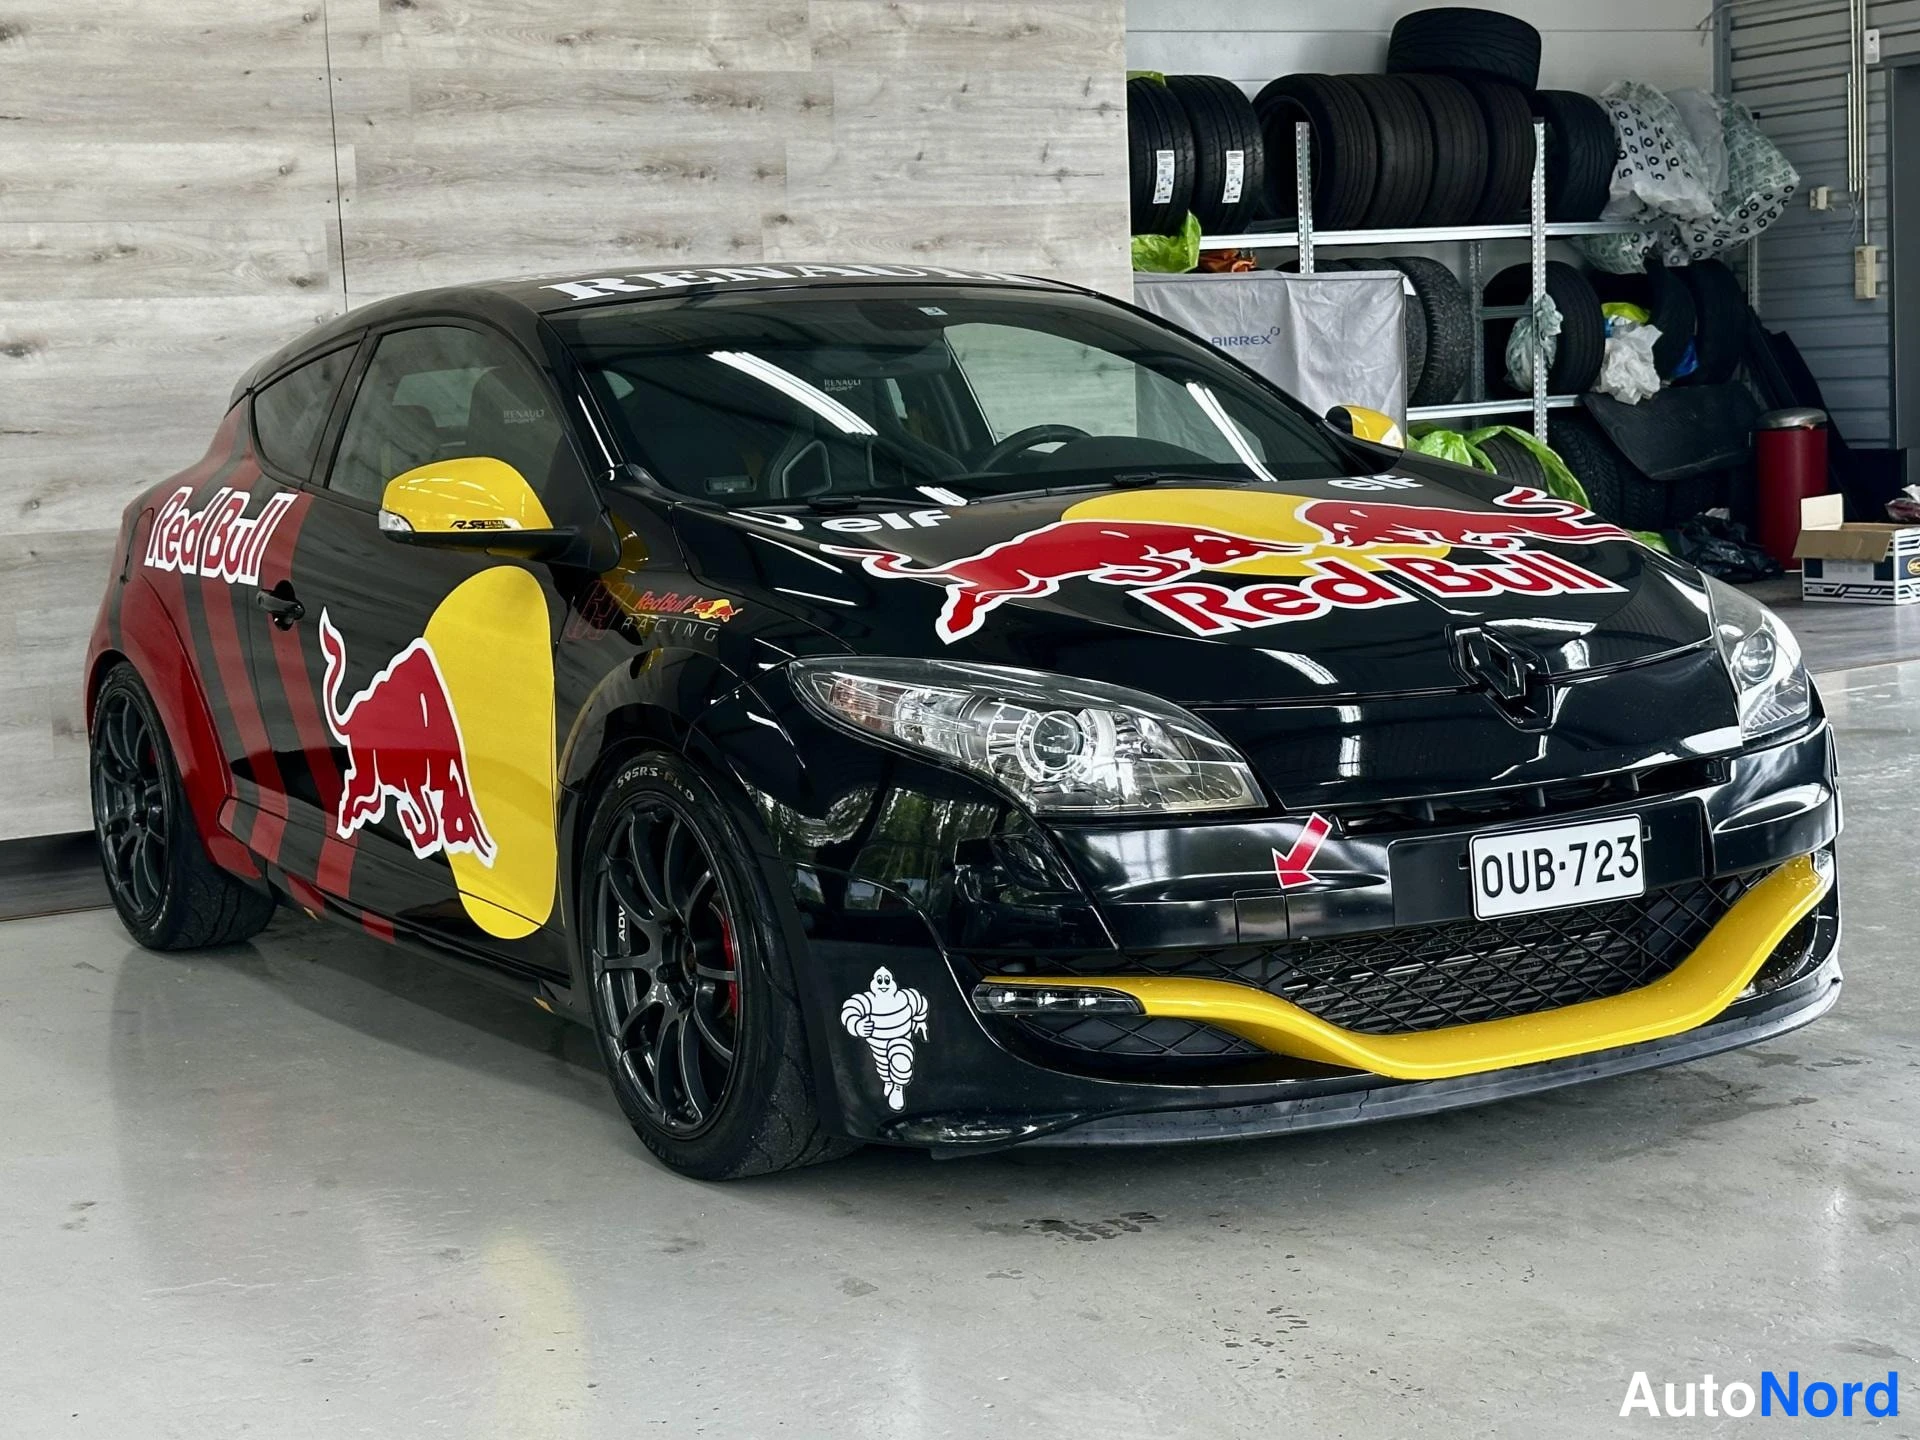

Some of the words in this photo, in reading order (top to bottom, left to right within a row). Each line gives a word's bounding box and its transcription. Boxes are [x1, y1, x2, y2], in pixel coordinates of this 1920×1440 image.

[1211, 334, 1272, 346] AIRREX
[1328, 475, 1424, 490] elf
[821, 510, 951, 533] elf
[1126, 556, 1419, 636] Red
[1365, 551, 1629, 597] Bull
[621, 616, 719, 642] RACING
[618, 904, 626, 942] ADV
